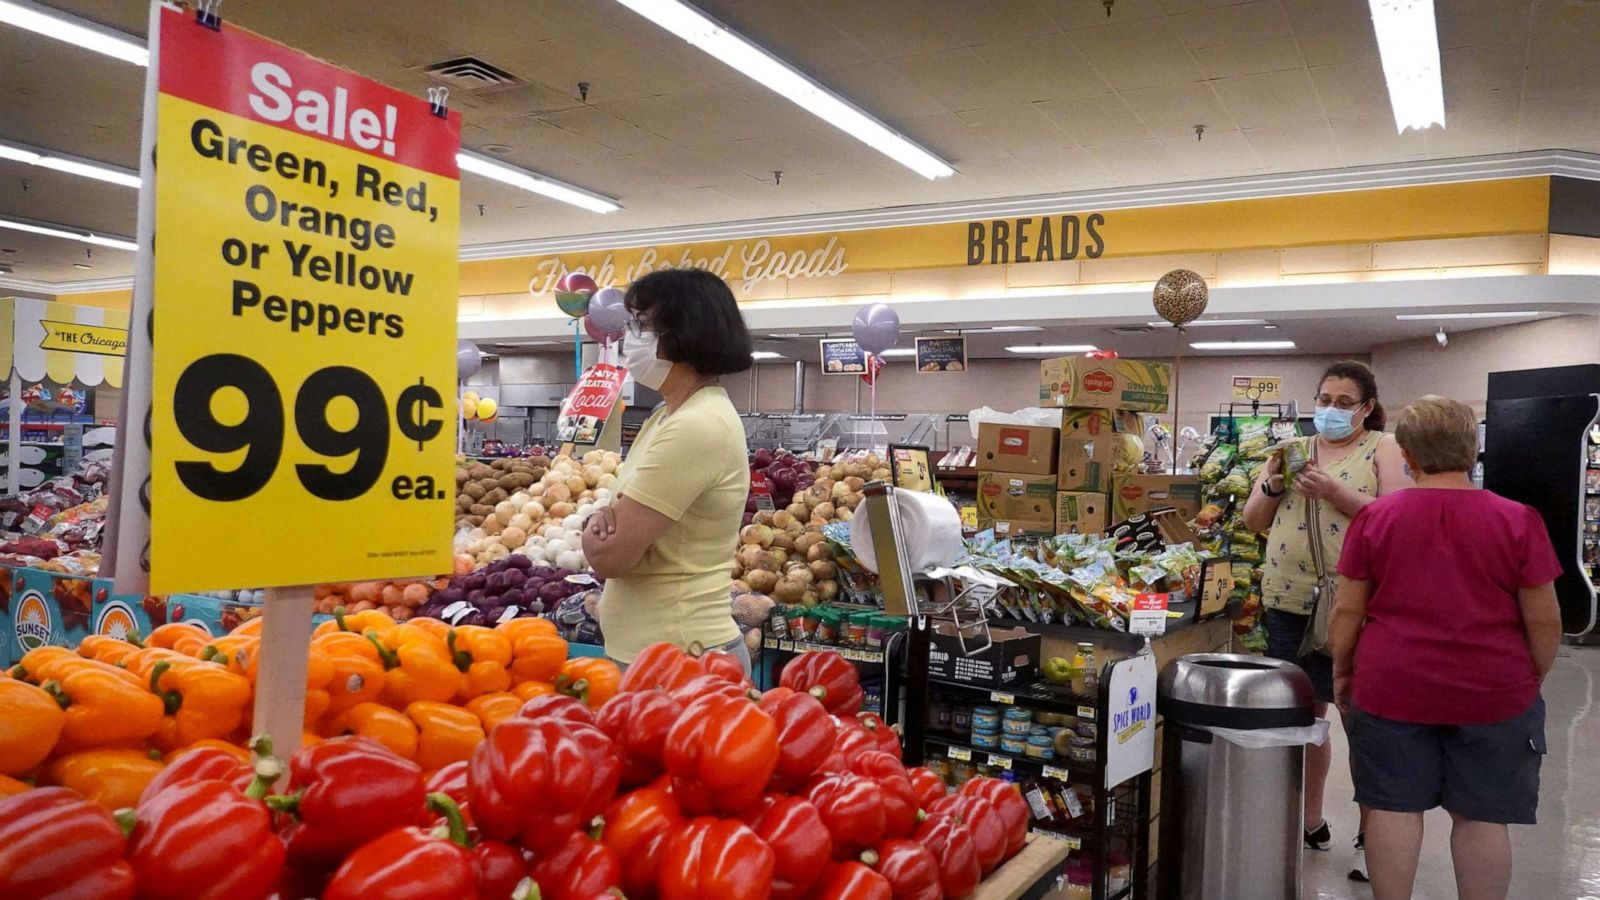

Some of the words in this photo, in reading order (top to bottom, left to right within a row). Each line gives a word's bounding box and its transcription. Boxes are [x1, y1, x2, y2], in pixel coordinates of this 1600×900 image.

[248, 61, 397, 156] Sale!
[190, 118, 339, 199] Green,
[355, 163, 438, 222] Red,
[245, 184, 396, 252] Orange
[967, 213, 1105, 266] BREADS
[221, 237, 270, 270] or
[282, 239, 414, 297] Yellow
[740, 236, 848, 291] Goods
[232, 279, 404, 339] Peppers
[80, 332, 126, 350] Chicago
[571, 388, 613, 412] Local
[391, 474, 446, 501] ea.
[16, 623, 51, 639] SUNSET
[1113, 710, 1129, 733] SPICE
[1131, 702, 1151, 726] WORLD
